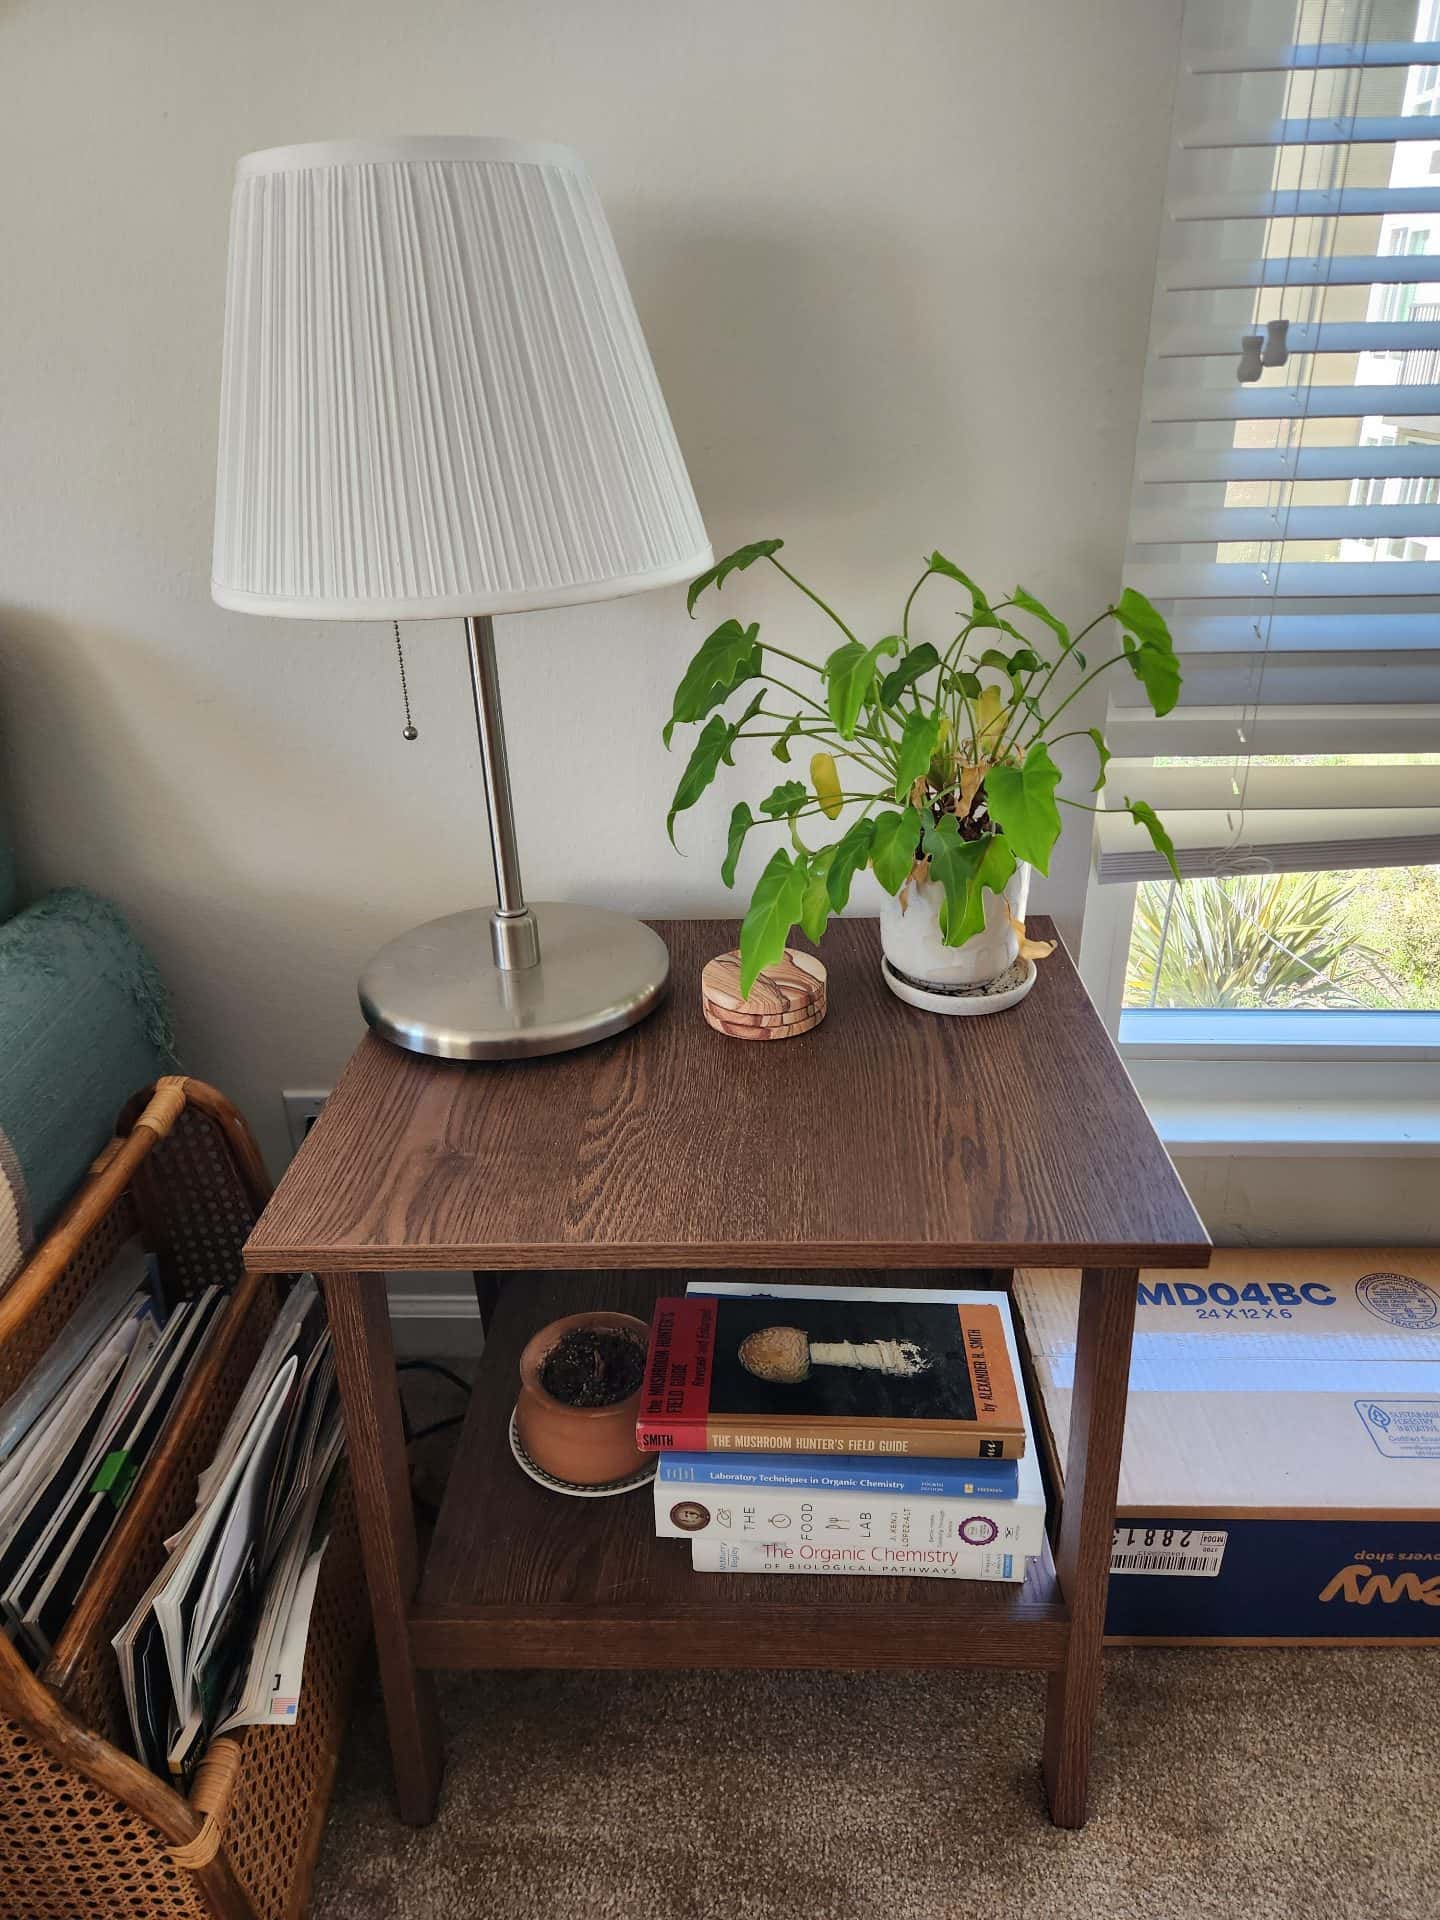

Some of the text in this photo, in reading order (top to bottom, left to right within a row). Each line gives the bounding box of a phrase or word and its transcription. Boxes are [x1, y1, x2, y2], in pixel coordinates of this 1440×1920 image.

[967, 1328, 984, 1349] SMITH
[647, 1312, 675, 1413] the MUSHROOM HUNTER'S
[667, 1364, 688, 1413] FIELD GUIDE
[973, 1360, 993, 1401] ALEXANDER
[981, 1402, 998, 1412] by
[642, 1434, 673, 1447] SMITH
[712, 1434, 909, 1452] THE MUSHROOM HUNTER'S FIELD GUIDE
[710, 1472, 905, 1490] Laboratory Techniques in Organic Chemistry
[743, 1506, 755, 1531] THE
[800, 1503, 813, 1541] FOOD
[859, 1512, 872, 1538] LAB
[762, 1543, 959, 1567] The Organic Chemistry
[1354, 1550, 1394, 1563] shop
[789, 1563, 873, 1572] BIOLOGICAL
[882, 1566, 957, 1575] PATHWAYS
